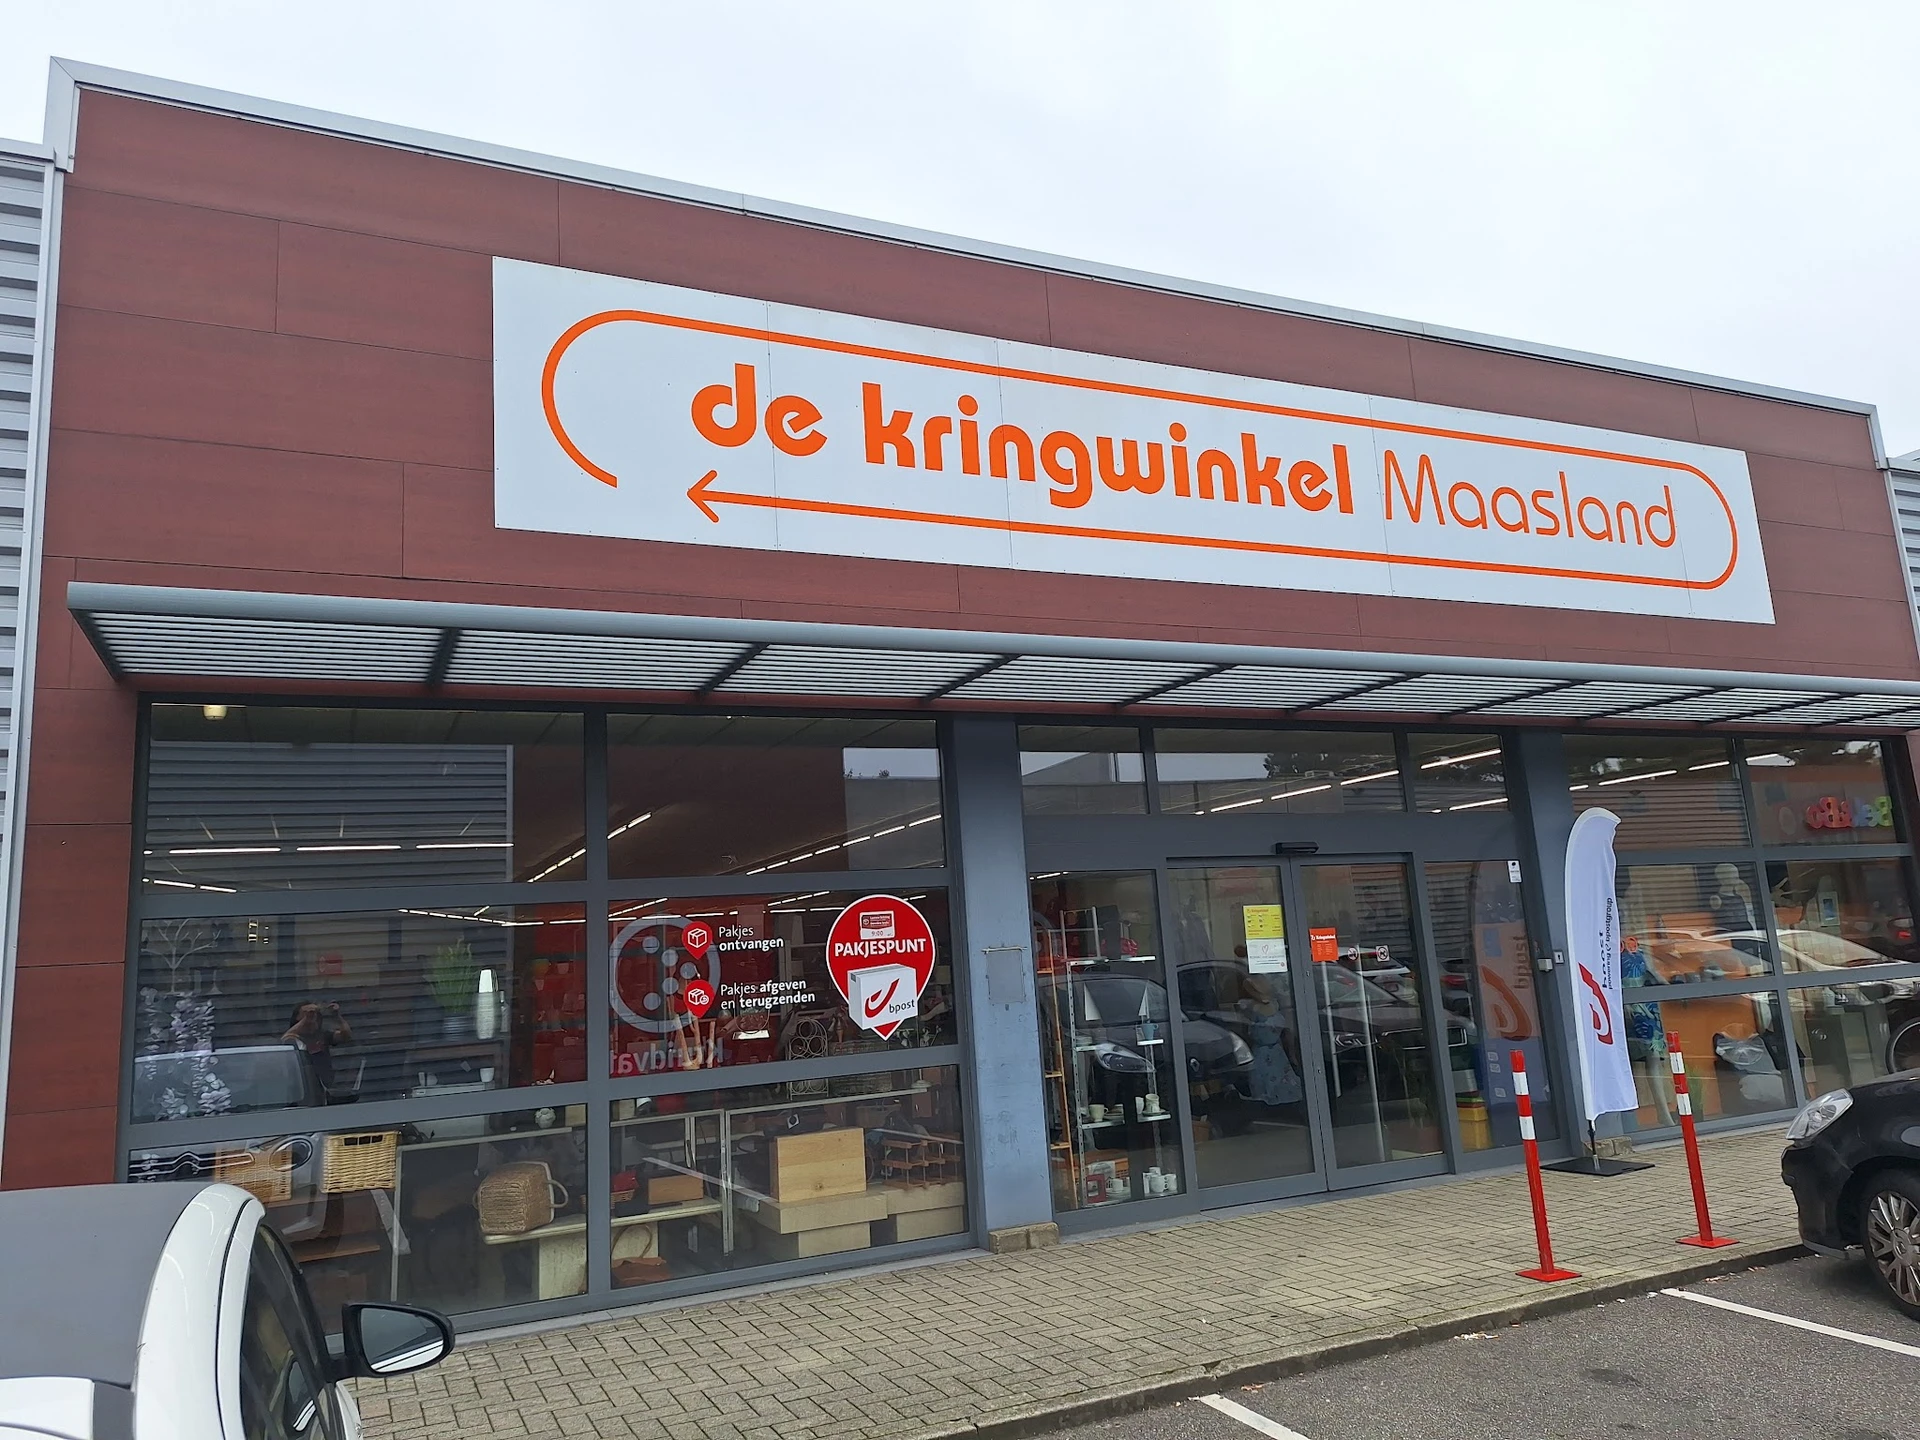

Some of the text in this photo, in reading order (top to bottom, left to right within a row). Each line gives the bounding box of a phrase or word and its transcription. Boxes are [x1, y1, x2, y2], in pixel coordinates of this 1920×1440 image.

[691, 363, 1677, 549] de kringwinkel Maasland
[1605, 897, 1614, 942] bpostgroup
[718, 924, 754, 940] Pakjes
[719, 937, 784, 952] ontvangen
[834, 938, 927, 959] PAKJESPUNT
[1512, 933, 1533, 990] bpost
[720, 979, 807, 997] Pakjes afgeven
[720, 990, 816, 1010] en terugzenden
[889, 999, 915, 1014] bpost
